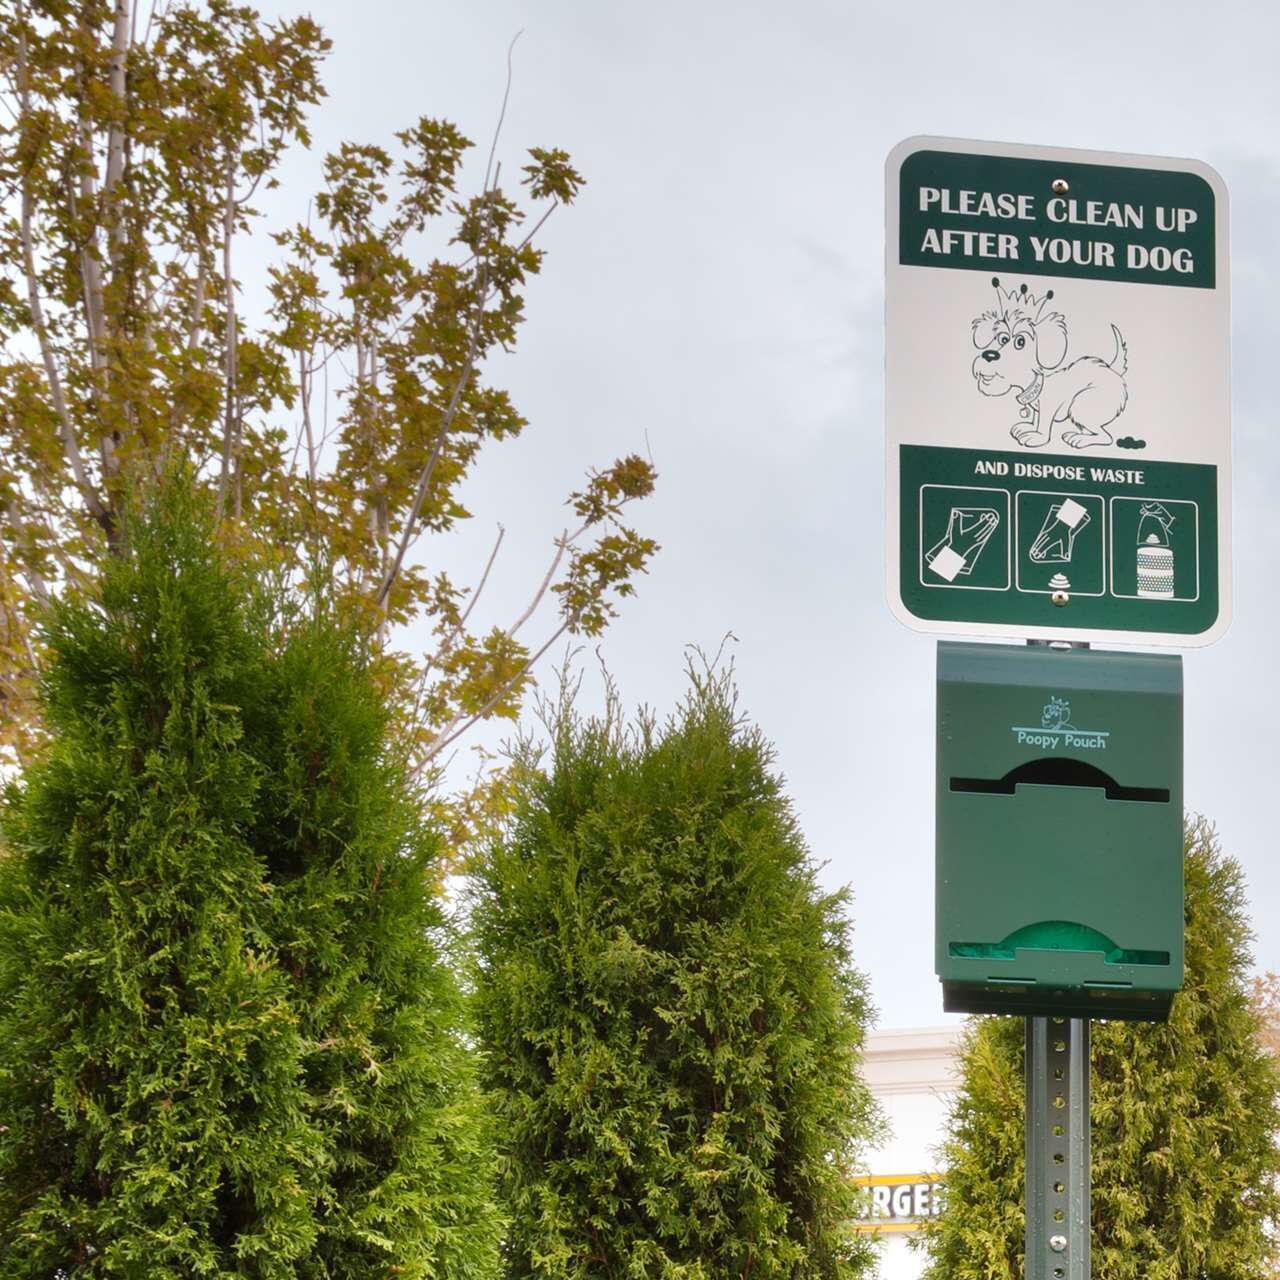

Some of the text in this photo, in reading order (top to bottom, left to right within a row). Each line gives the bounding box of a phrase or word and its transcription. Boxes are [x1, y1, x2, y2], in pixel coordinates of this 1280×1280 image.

[920, 186, 1198, 233] PLEASE CLEAN UP
[920, 228, 1194, 274] AFTER YOUR DOG
[974, 460, 1145, 485] AND DISPOSE WASTE
[1017, 730, 1106, 750] Poopy Pouch
